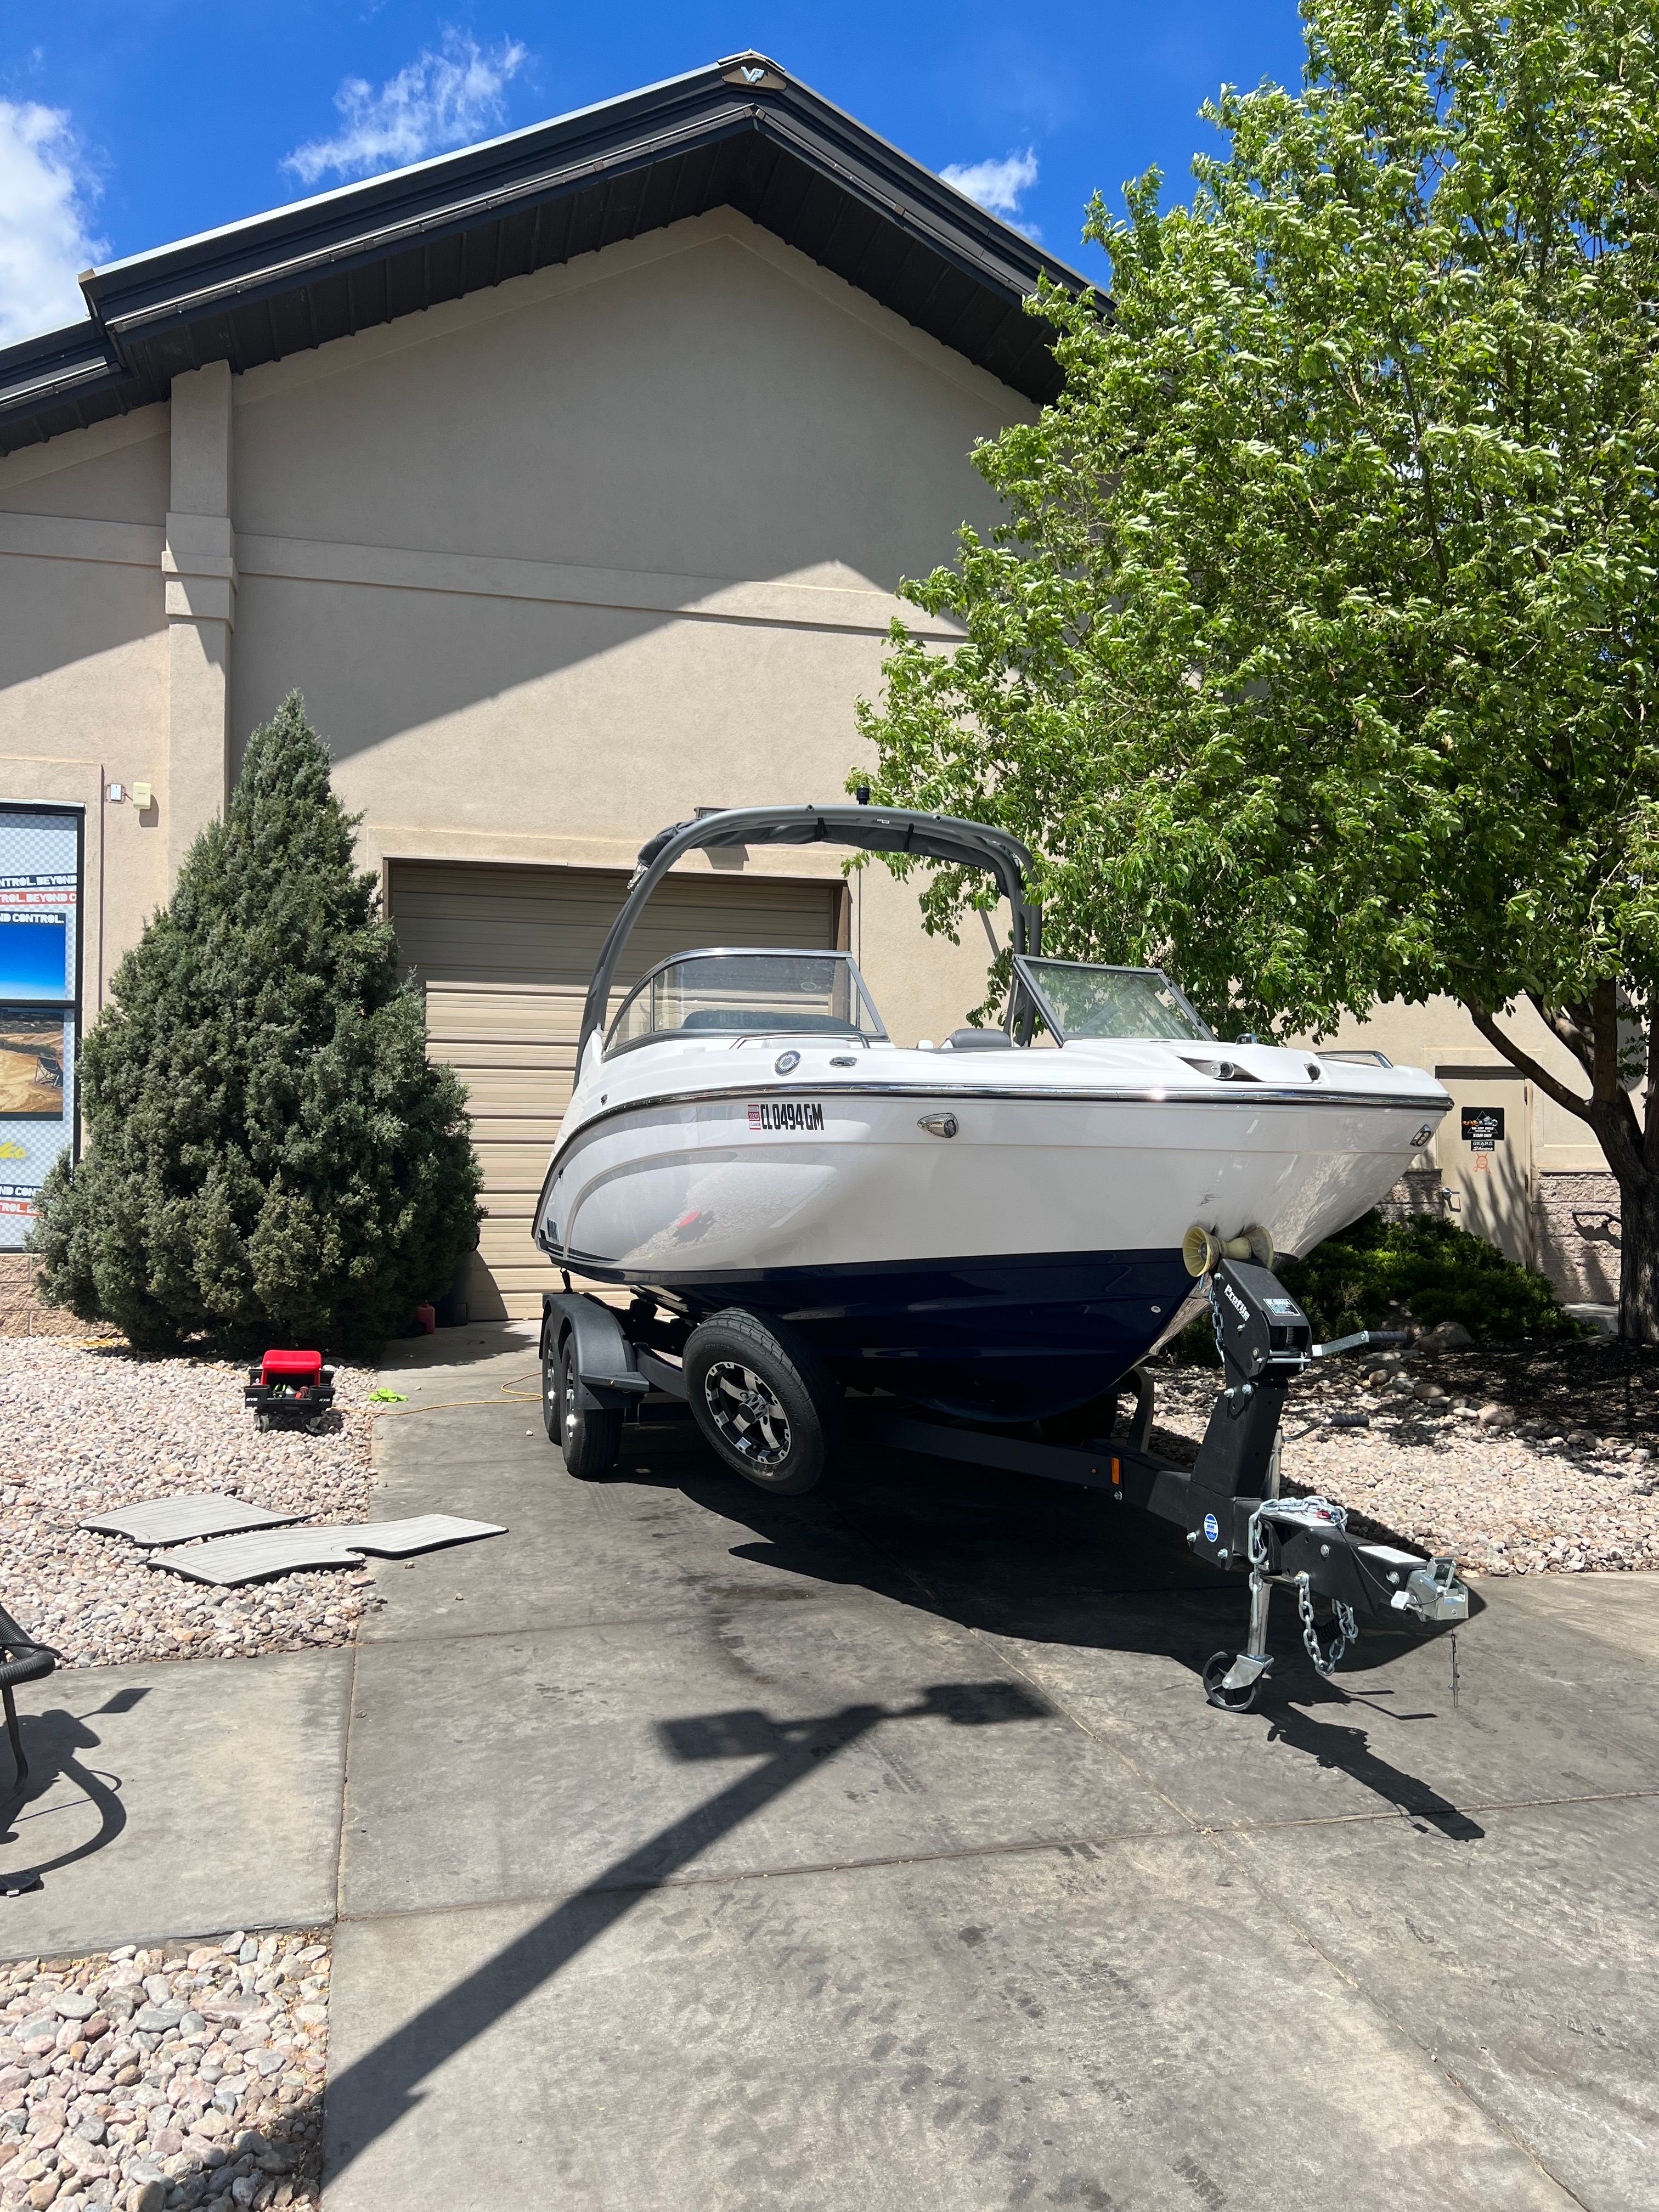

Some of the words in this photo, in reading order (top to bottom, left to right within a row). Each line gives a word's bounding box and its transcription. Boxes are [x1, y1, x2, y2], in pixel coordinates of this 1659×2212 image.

[36, 875, 77, 885] BEYOND
[26, 893, 67, 902] BEYOND
[12, 913, 64, 923] CONTROL.
[1224, 1284, 1250, 1319] Profile
